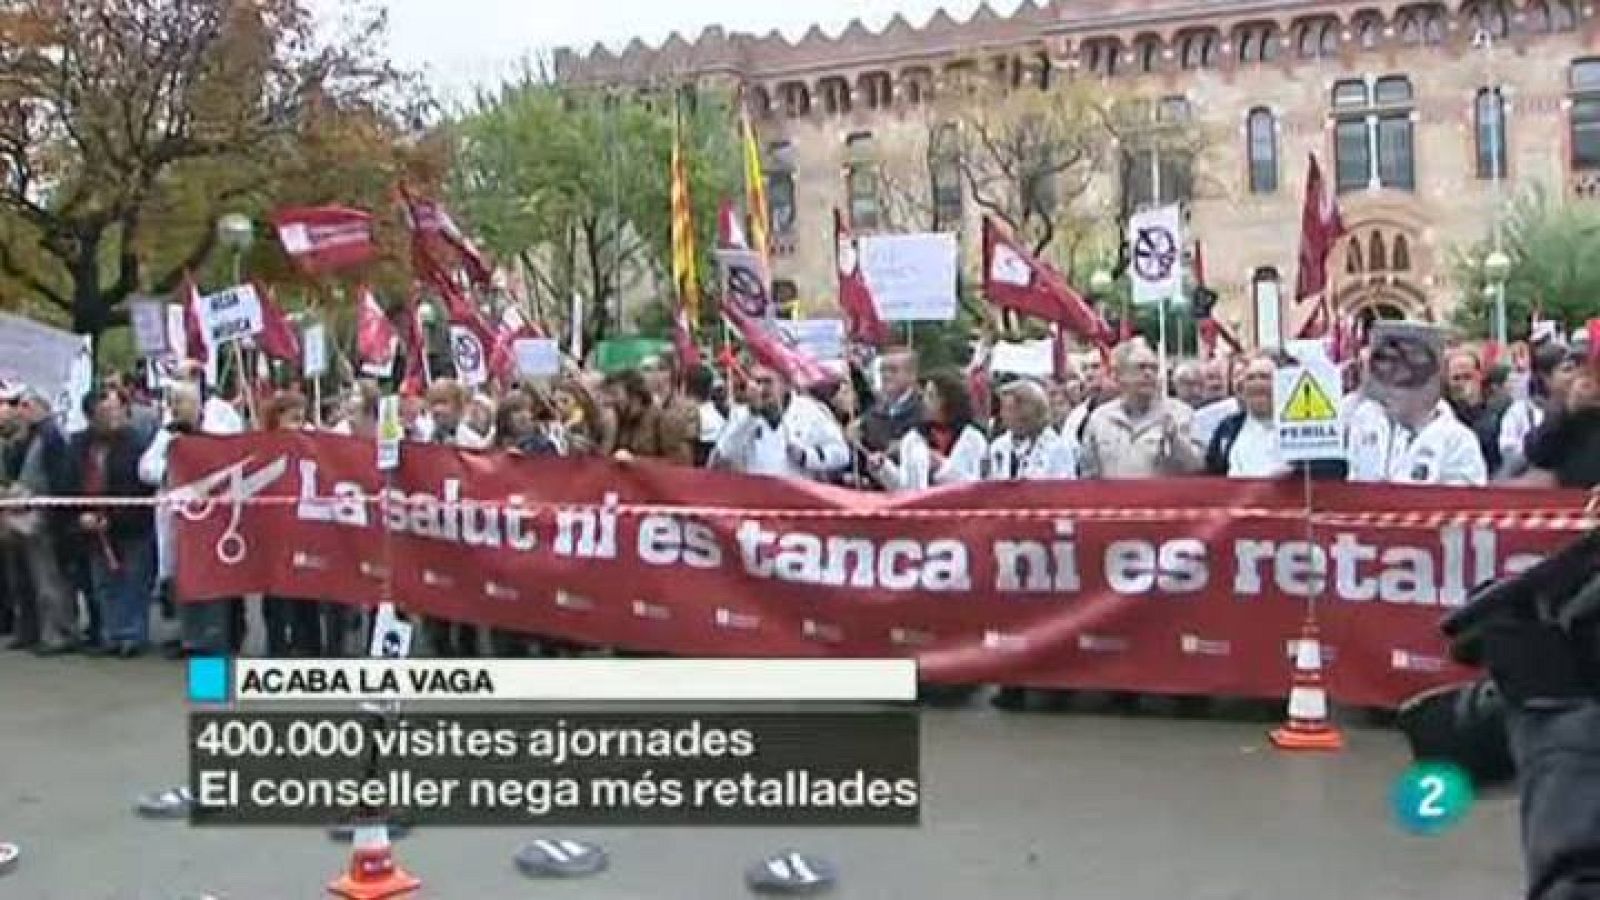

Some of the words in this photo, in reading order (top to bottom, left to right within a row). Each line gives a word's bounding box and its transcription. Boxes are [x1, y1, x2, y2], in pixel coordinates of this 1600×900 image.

[298, 459, 368, 527] La
[384, 479, 538, 550] salut
[552, 491, 619, 559] ni
[637, 511, 722, 568] es
[735, 518, 971, 591] tanca
[994, 518, 1081, 592] ni
[1103, 536, 1210, 594] es
